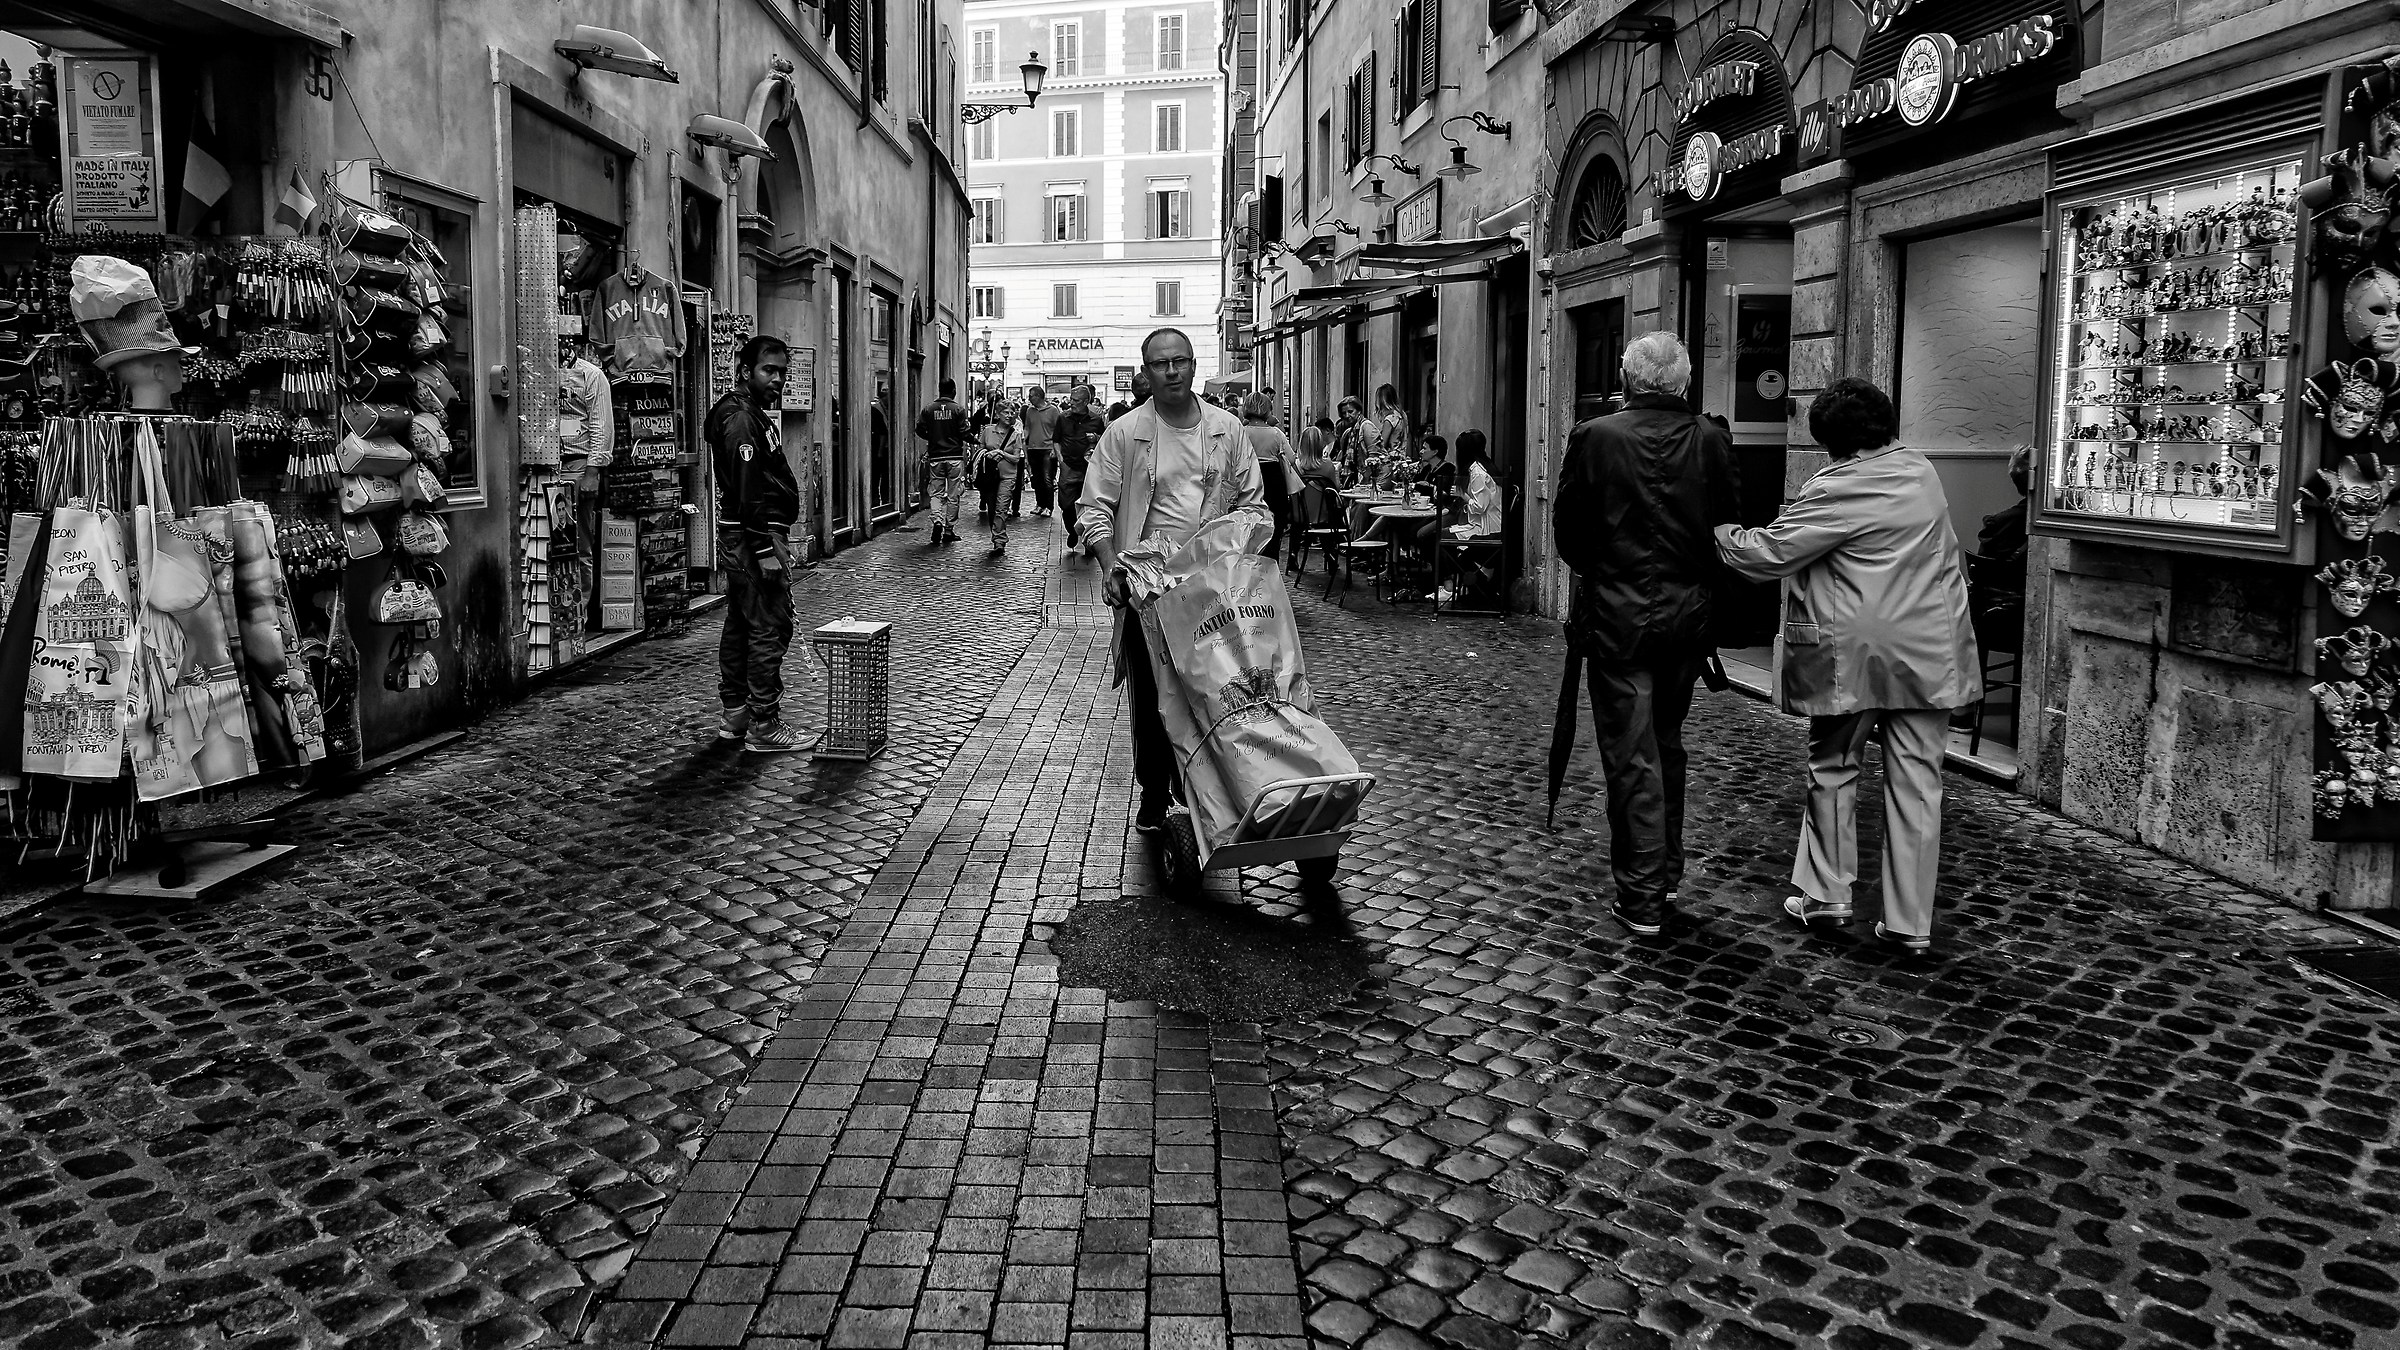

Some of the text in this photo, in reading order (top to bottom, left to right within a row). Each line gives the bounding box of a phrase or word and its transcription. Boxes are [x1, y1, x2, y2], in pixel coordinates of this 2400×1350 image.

[1953, 15, 2054, 84] DRINKS
[303, 54, 334, 101] 95
[1671, 60, 1760, 124] GOURMET
[1834, 78, 1896, 128] FOOD
[82, 105, 135, 117] VIETATO FUMARE
[1801, 110, 1824, 153] illy
[75, 160, 150, 171] MADE IN ITALY
[75, 172, 125, 181] PRODOTTO
[75, 181, 118, 189] ITALIANO
[605, 296, 668, 322] ITALIA
[1028, 339, 1104, 350] FARMACIA
[635, 398, 670, 410] ROMA
[657, 417, 672, 429] 215
[50, 528, 76, 539] HEON
[608, 527, 632, 537] ROMA
[63, 549, 87, 562] SAN
[607, 552, 631, 562] SPQR
[58, 561, 96, 577] PIETRO
[1193, 604, 1275, 643] L'ANTICO FORNO
[1232, 643, 1255, 657] Roma
[26, 743, 108, 755] FONTANA DI TREVI
[1234, 748, 1241, 759] di
[1264, 739, 1306, 762] dal 1939
